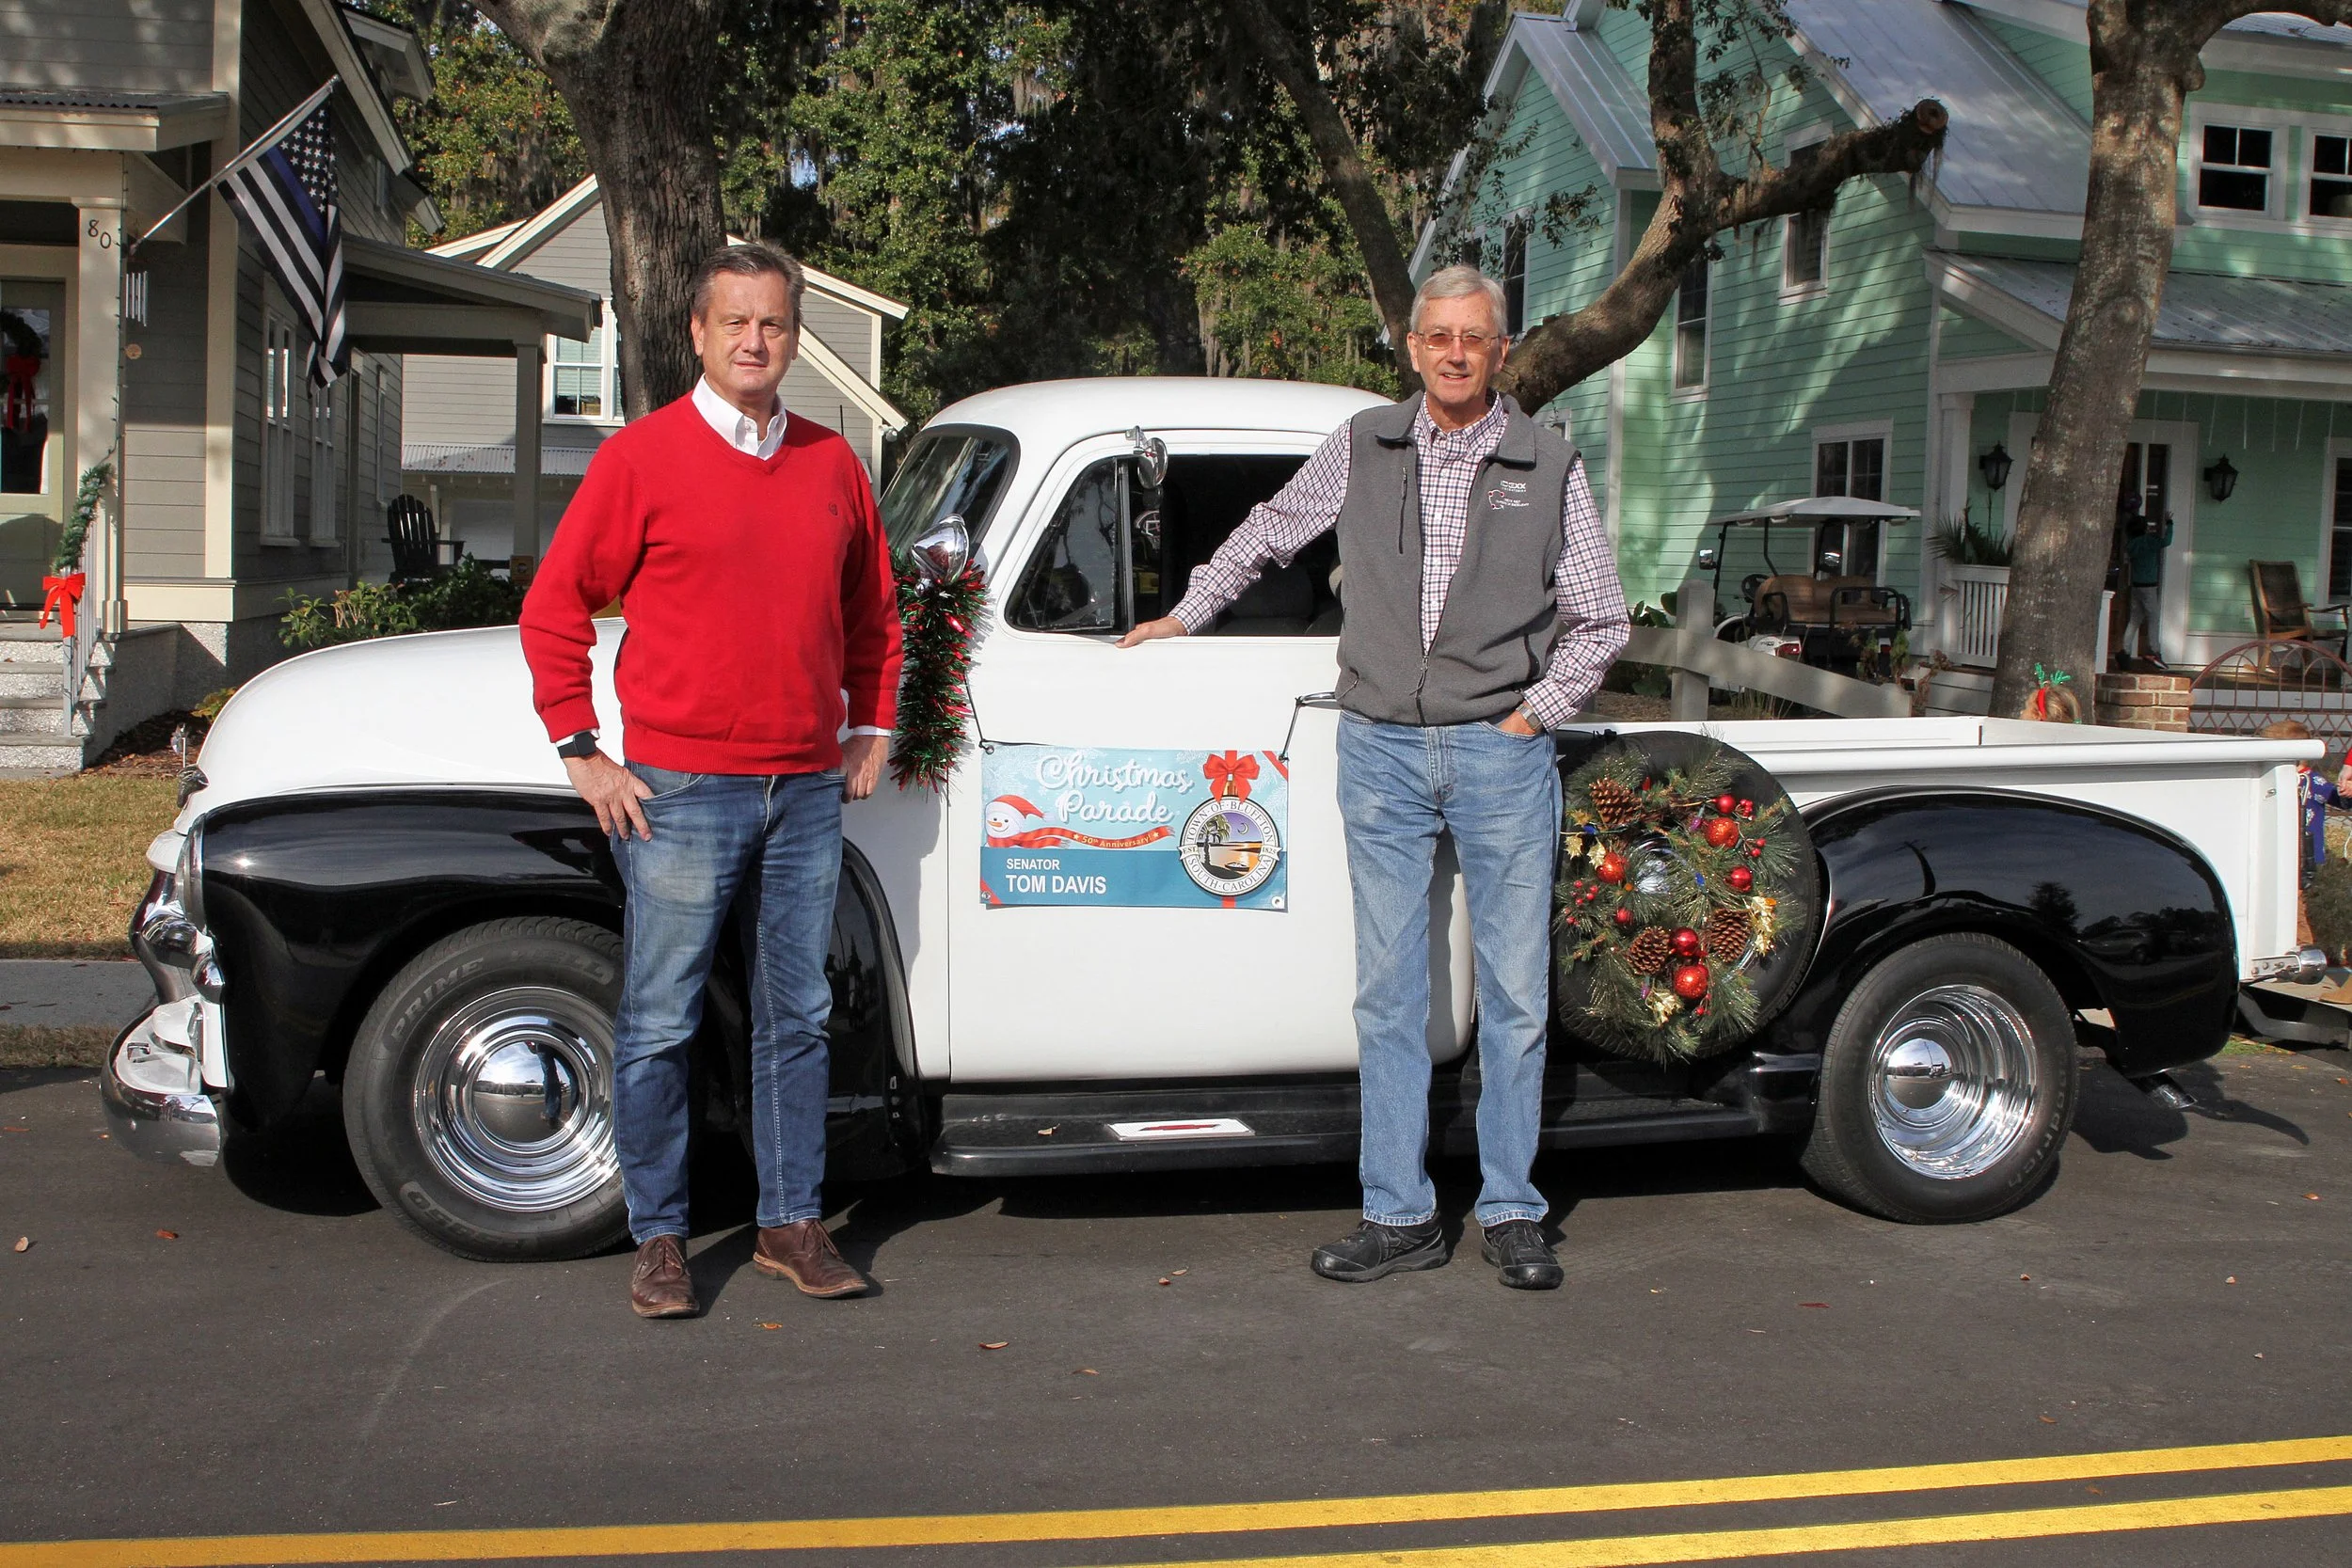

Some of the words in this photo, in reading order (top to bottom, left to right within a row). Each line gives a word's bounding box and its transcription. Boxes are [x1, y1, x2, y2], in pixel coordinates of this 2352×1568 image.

[87, 219, 112, 249] 80
[1037, 751, 1195, 794] Christmas
[1055, 790, 1175, 824] Parade
[1186, 813, 1208, 842] TOWN
[1210, 802, 1225, 812] OF
[1230, 800, 1274, 843] BLUFFTON
[1081, 835, 1099, 844] 50th
[1099, 834, 1151, 847] Anniversary!
[1006, 858, 1060, 870] SENATOR
[1188, 857, 1219, 890] SOUTH
[1222, 858, 1272, 892] CAROLINA
[1005, 874, 1046, 893] TOM
[1052, 875, 1107, 894] DAVIS
